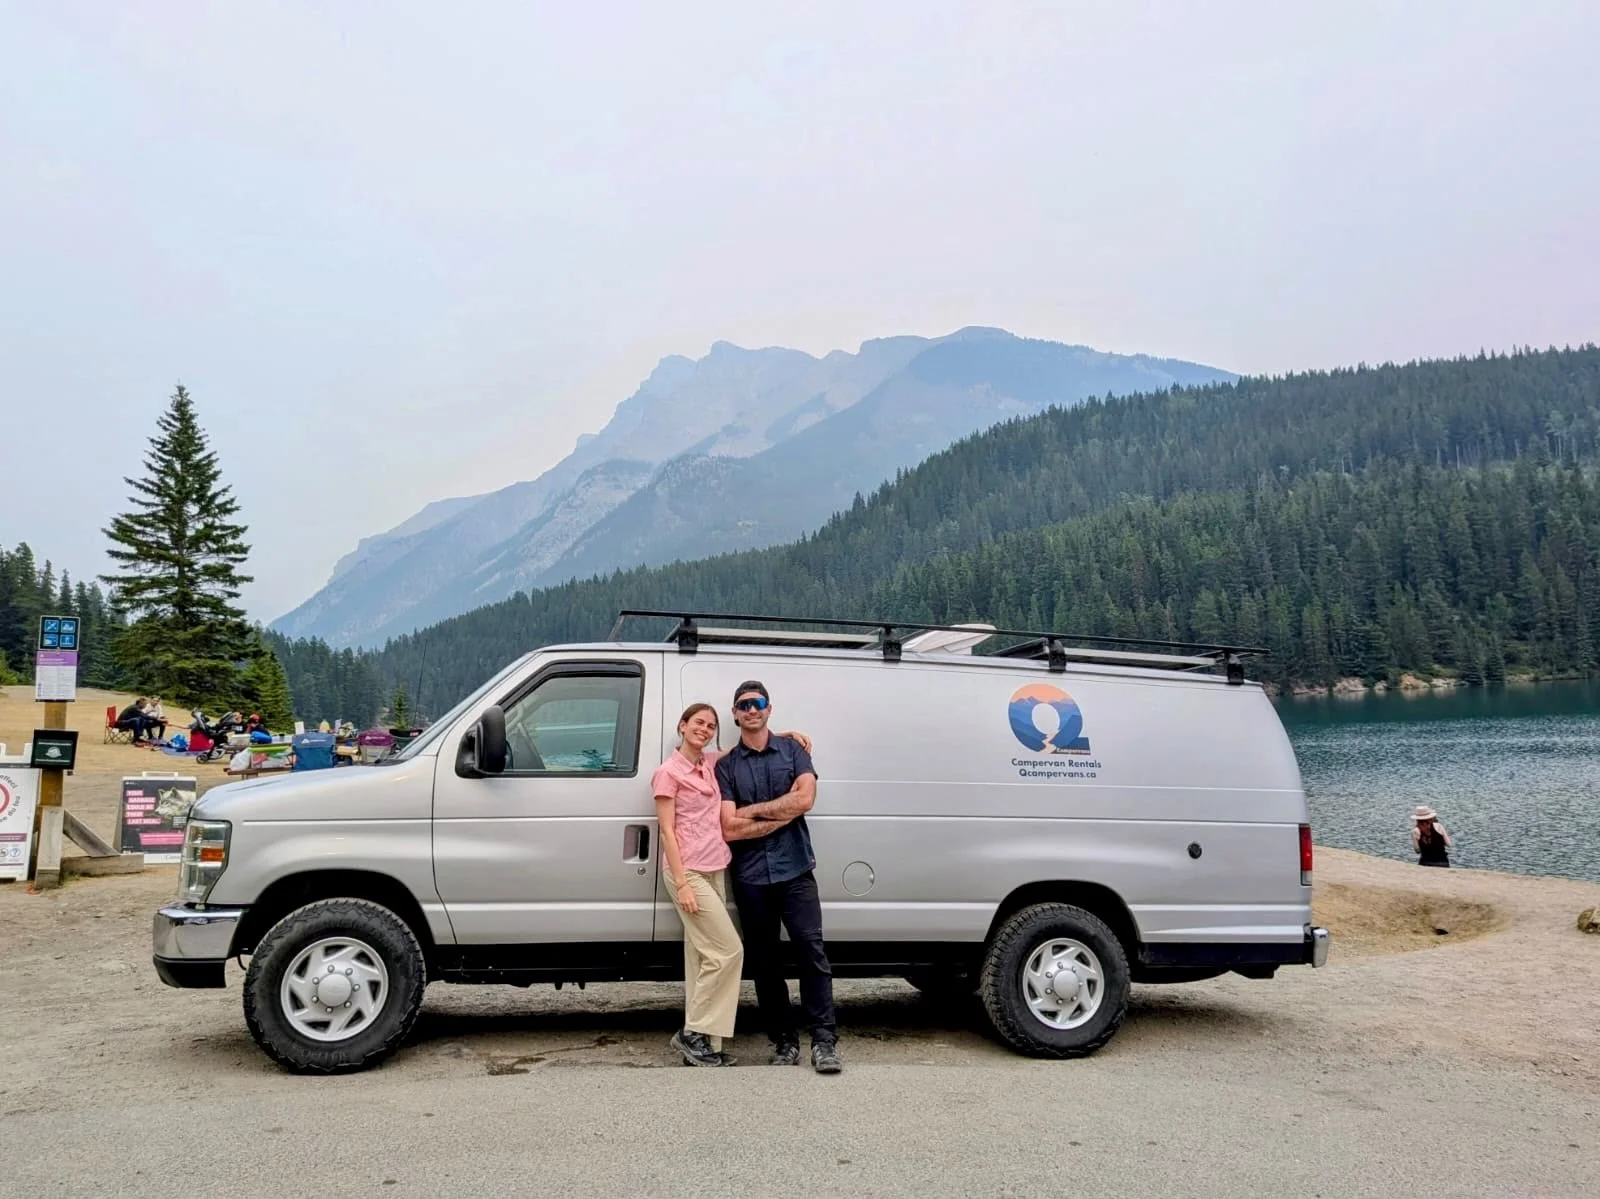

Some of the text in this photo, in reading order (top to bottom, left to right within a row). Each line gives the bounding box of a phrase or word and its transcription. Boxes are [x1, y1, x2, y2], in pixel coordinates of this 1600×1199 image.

[1011, 758, 1102, 769] Campervan Rentals
[1019, 769, 1097, 780] Qcampervans.ca
